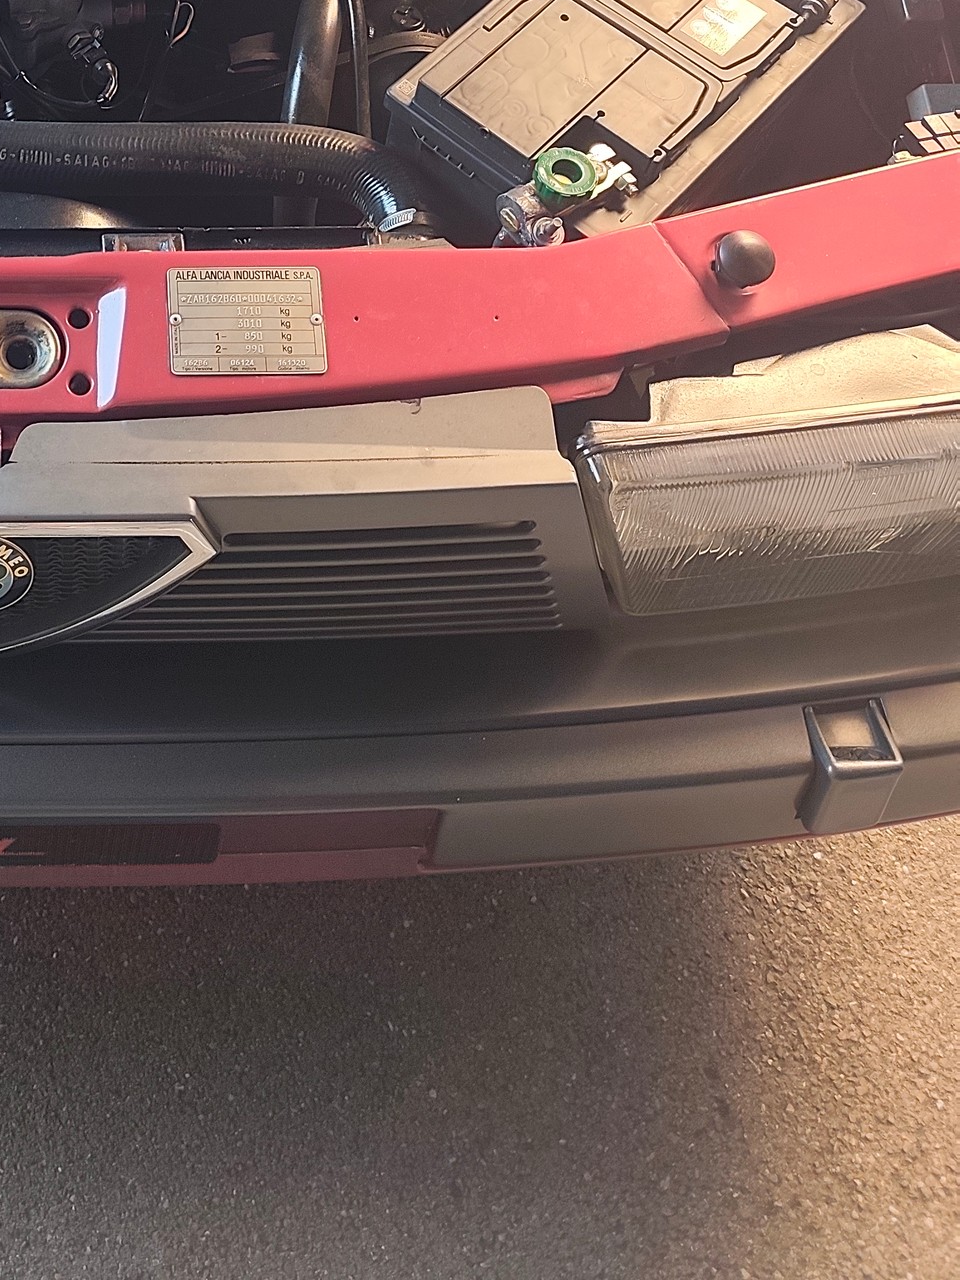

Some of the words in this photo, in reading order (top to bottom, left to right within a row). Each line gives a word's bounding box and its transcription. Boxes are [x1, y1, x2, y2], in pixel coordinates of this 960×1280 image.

[175, 270, 197, 280] ALFA
[199, 270, 231, 280] LANCIA
[233, 270, 290, 280] INDUSTRIALE
[293, 271, 314, 280] S.P.A.
[237, 306, 262, 316] 1710
[279, 307, 290, 316] kg
[280, 319, 291, 329] kg
[244, 332, 263, 341] 850
[281, 332, 292, 341] kg
[245, 345, 264, 353] 990
[282, 344, 293, 354] kg
